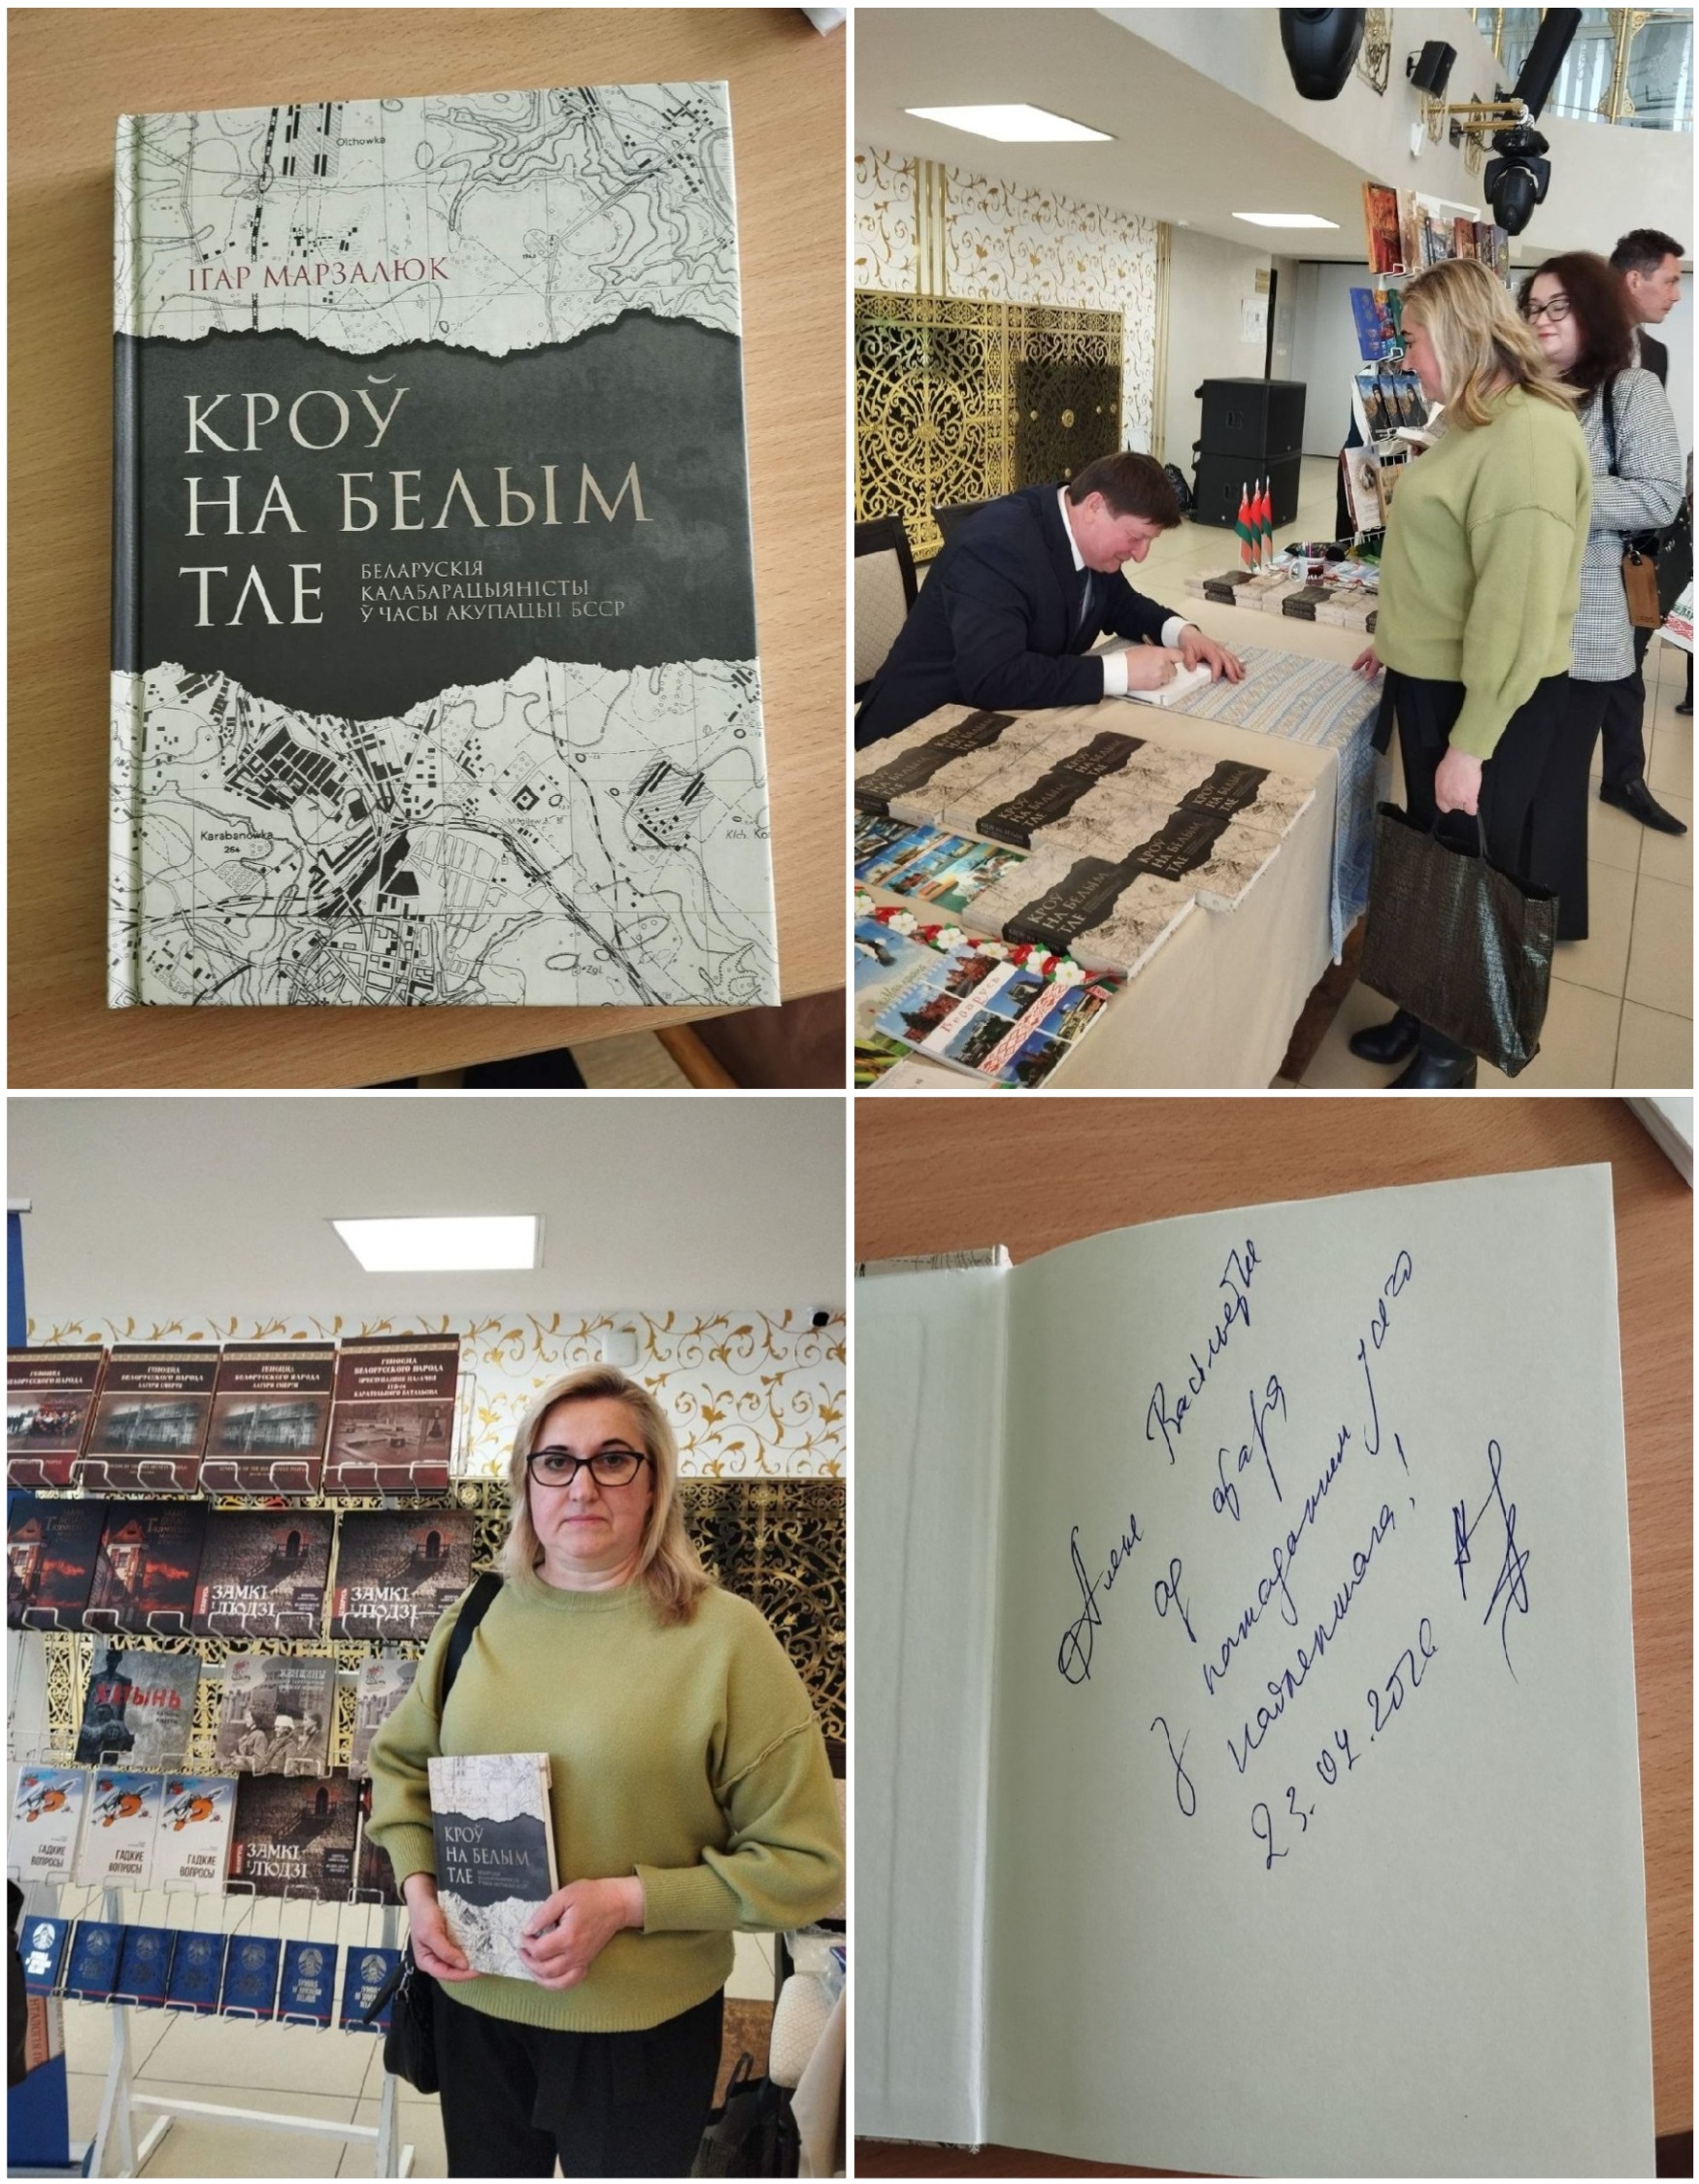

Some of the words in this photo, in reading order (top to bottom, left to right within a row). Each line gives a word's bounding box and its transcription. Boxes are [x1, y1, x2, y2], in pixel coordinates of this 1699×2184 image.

[187, 265, 252, 292] ІГАР
[263, 256, 450, 289] МАРЗАЛЮК
[183, 374, 410, 454] КРОЎ
[183, 475, 307, 537] НА
[337, 461, 653, 533] БЕЛЫМ
[361, 560, 483, 579] БЕЛАРУСКІЯ
[178, 562, 324, 627] ТЛЕ
[361, 579, 589, 602] КАЛАБАРАЦЫЯНІСТЫ
[360, 604, 374, 623] Ў
[380, 606, 438, 623] ЧАСЫ
[446, 602, 562, 621] АКУПАЦЫІ
[571, 601, 625, 618] БССР
[200, 830, 274, 841] Karabanowka
[212, 1584, 268, 1601] ЗАМКІ
[350, 1586, 410, 1603] ЗАМКІ
[93, 1684, 182, 1710] ХАТЫНЬ
[445, 1824, 483, 1843] КРОЎ
[116, 1849, 145, 1862] ГАДКИЕ
[187, 1854, 217, 1866] ГАДКИЕ
[247, 1843, 301, 1861] ЗАМКІ
[447, 1846, 468, 1863] НА
[473, 1848, 530, 1866] БЕЛЫМ
[30, 1856, 64, 1868] ВОПРОСЫ
[109, 1862, 143, 1874] ВОПРОСЫ
[180, 1866, 215, 1878] ВОПРОСЫ
[447, 1867, 473, 1884] ТЛЕ
